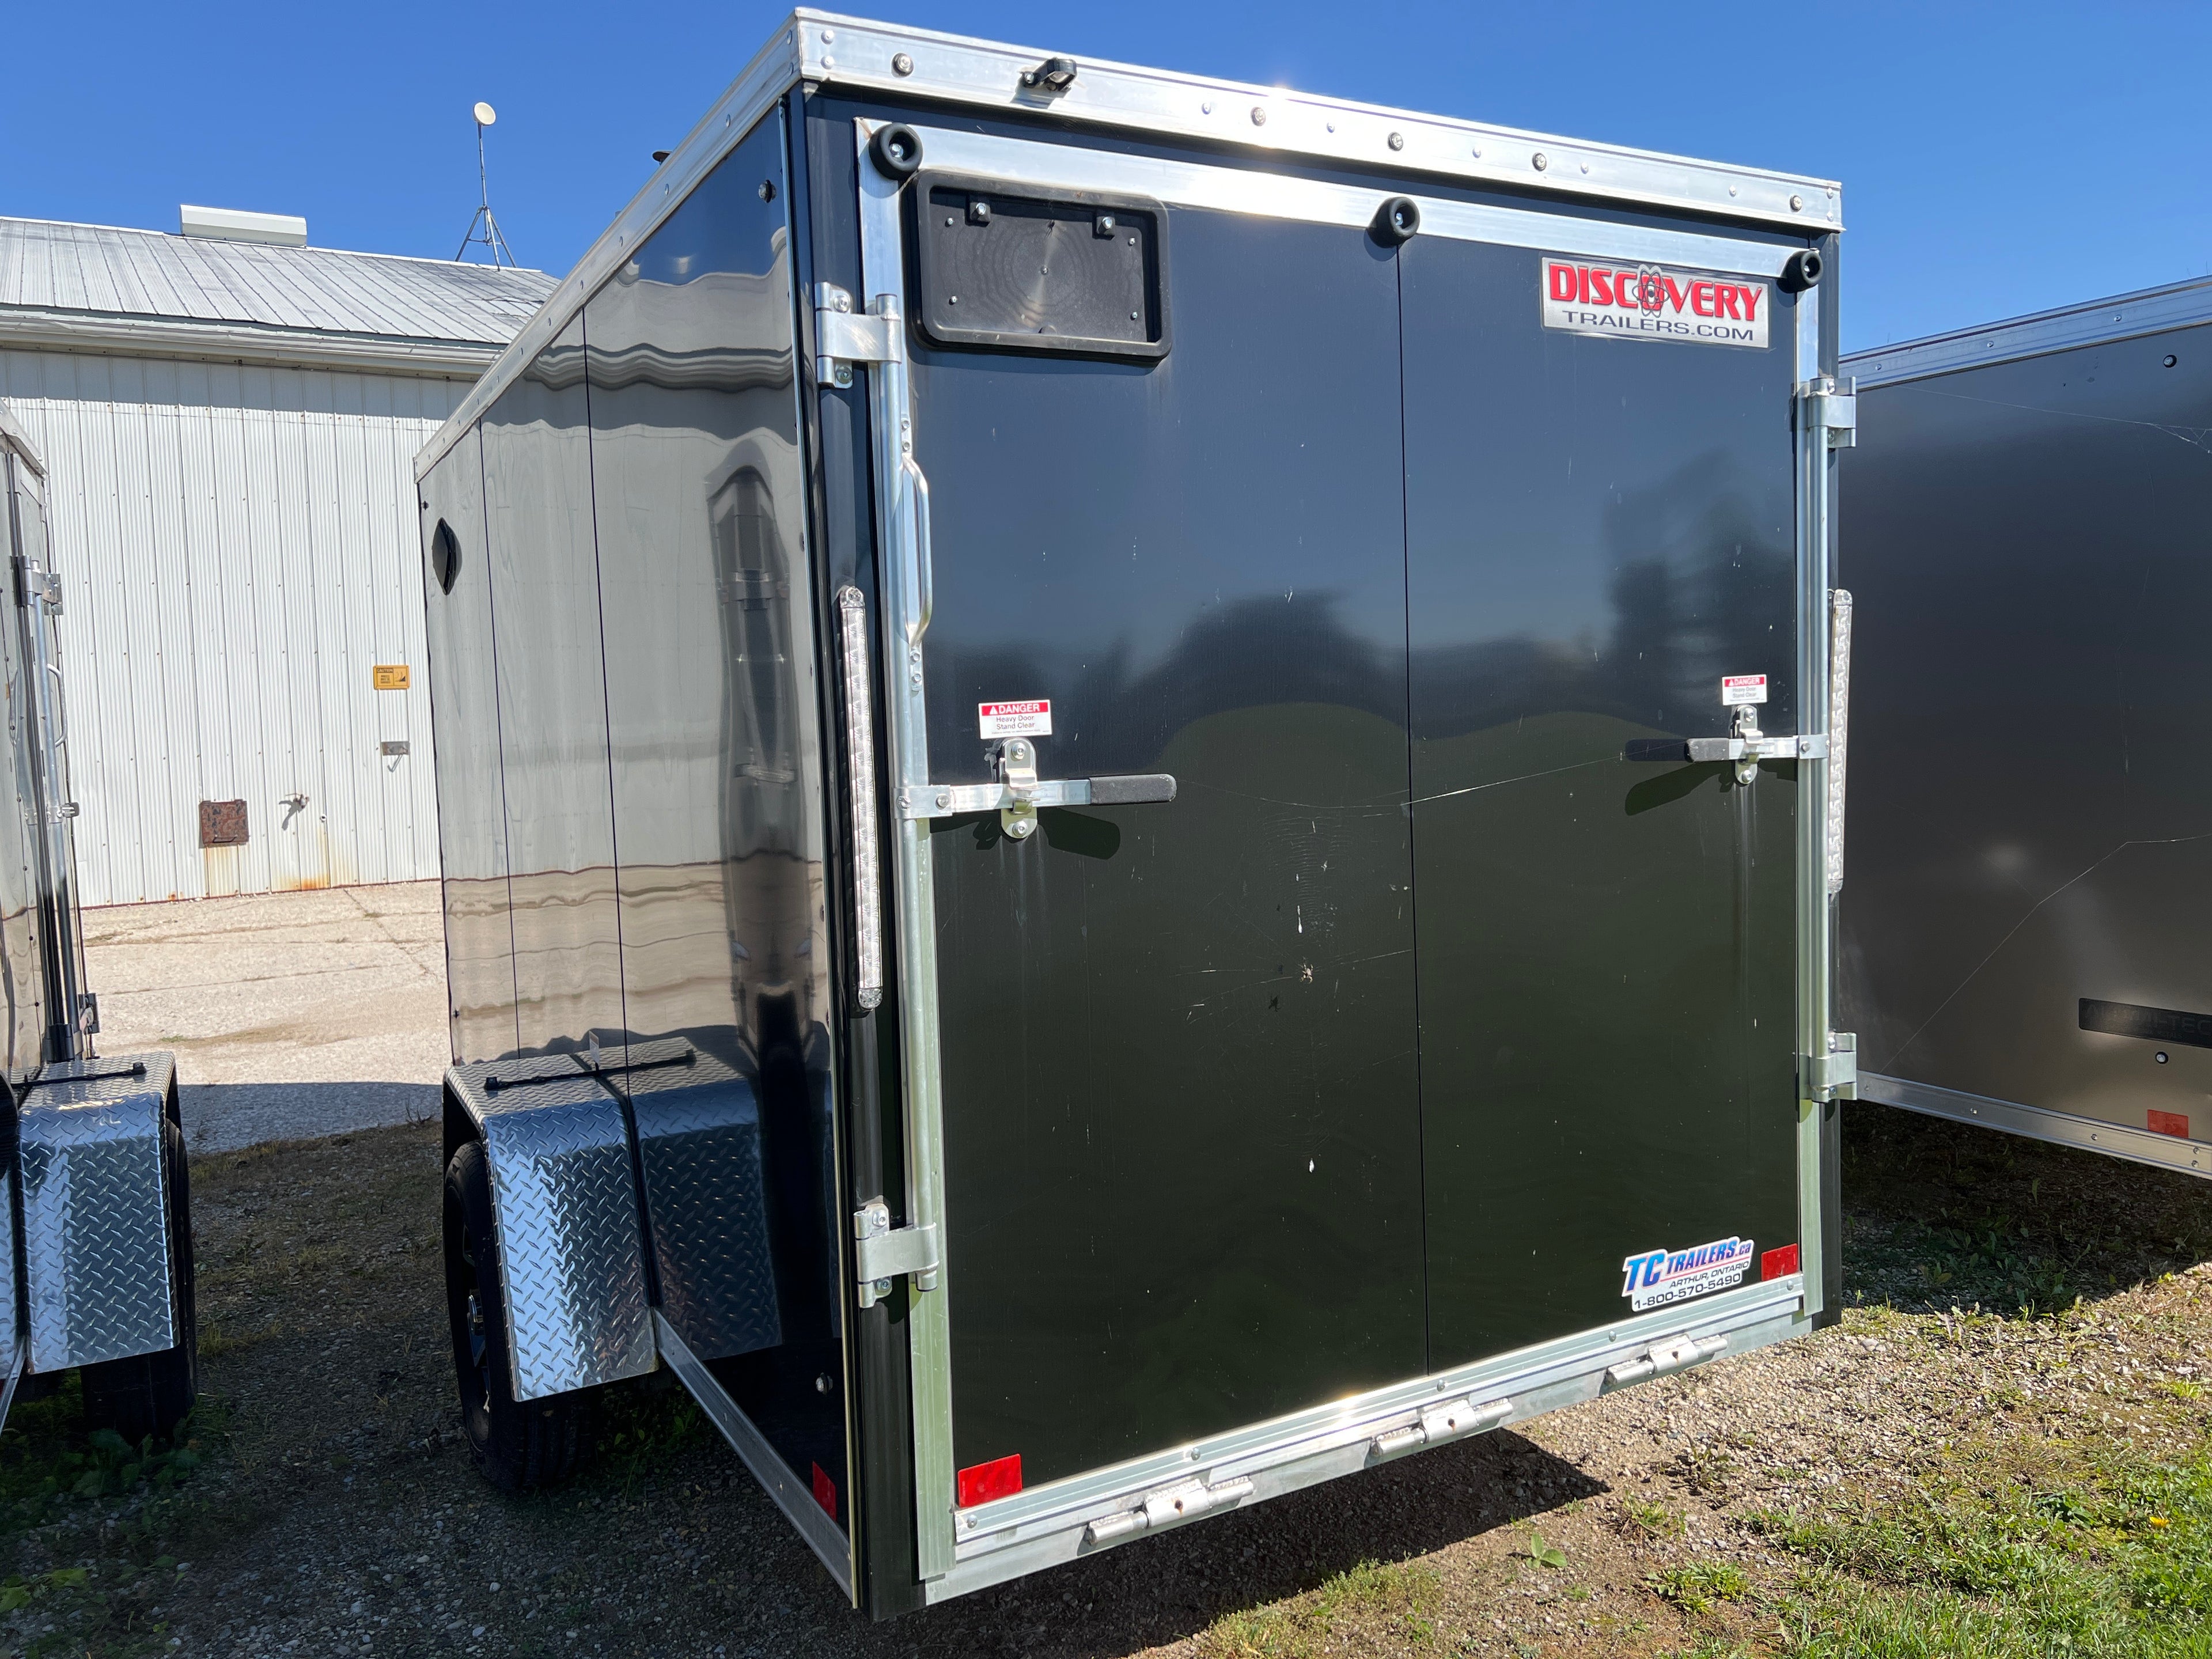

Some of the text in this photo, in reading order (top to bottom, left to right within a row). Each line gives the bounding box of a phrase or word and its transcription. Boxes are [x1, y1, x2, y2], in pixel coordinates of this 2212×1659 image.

[1549, 263, 1762, 321] DISCOVERY
[1562, 310, 1753, 341] TRAILERS.COM
[1734, 677, 1760, 685] DANGER
[998, 703, 1040, 714] DANGER
[1625, 1239, 1751, 1293] TC TRAILERS.ca
[1669, 1260, 1749, 1289] ARTHUR, ONTARIO
[1634, 1272, 1741, 1309] 1-800-570-5490
